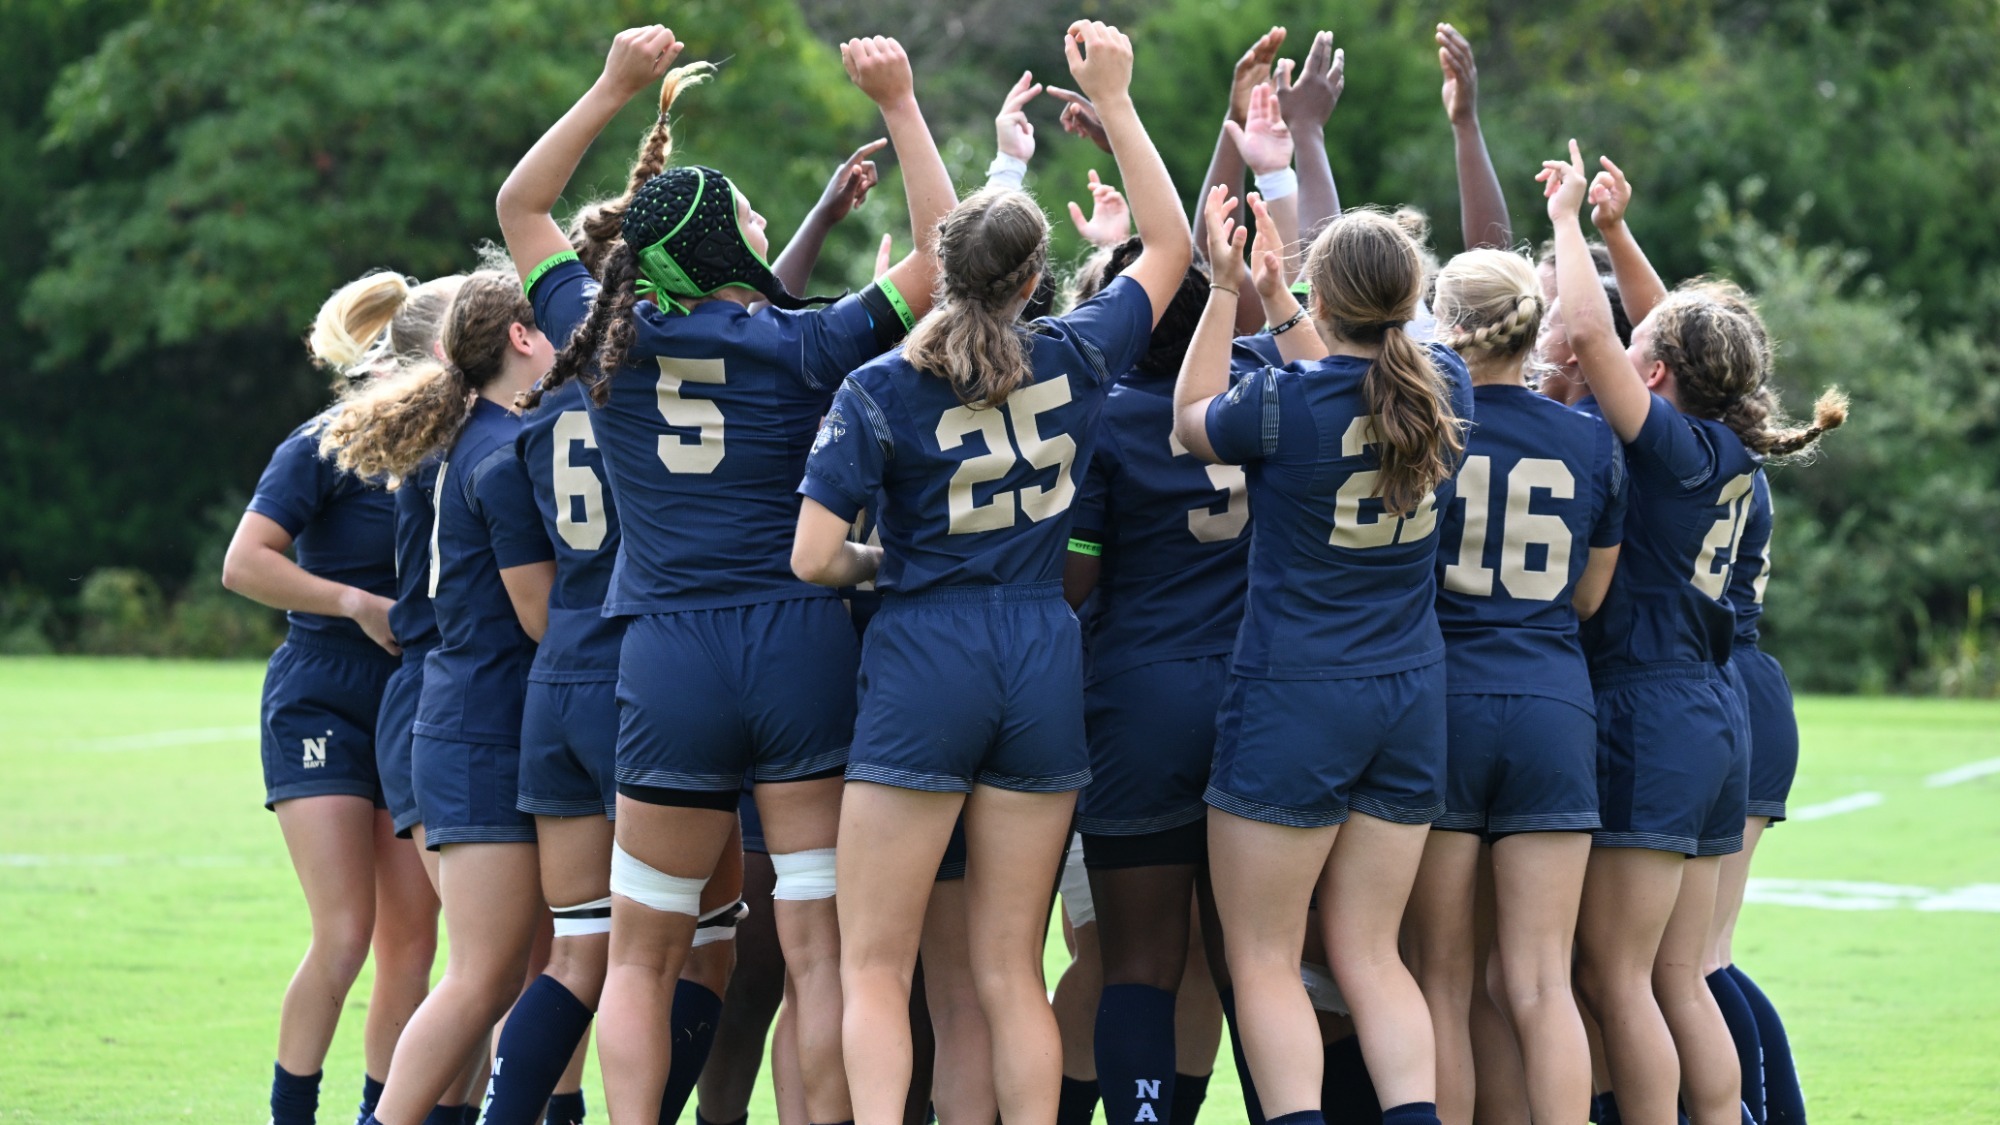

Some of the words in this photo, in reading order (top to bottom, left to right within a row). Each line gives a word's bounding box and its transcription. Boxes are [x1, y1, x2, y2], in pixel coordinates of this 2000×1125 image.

[656, 355, 726, 474] 5
[935, 373, 1077, 535] 25
[553, 411, 607, 550] 6
[1443, 455, 1576, 601] 16
[302, 737, 327, 761] N
[303, 760, 326, 769] NAVY
